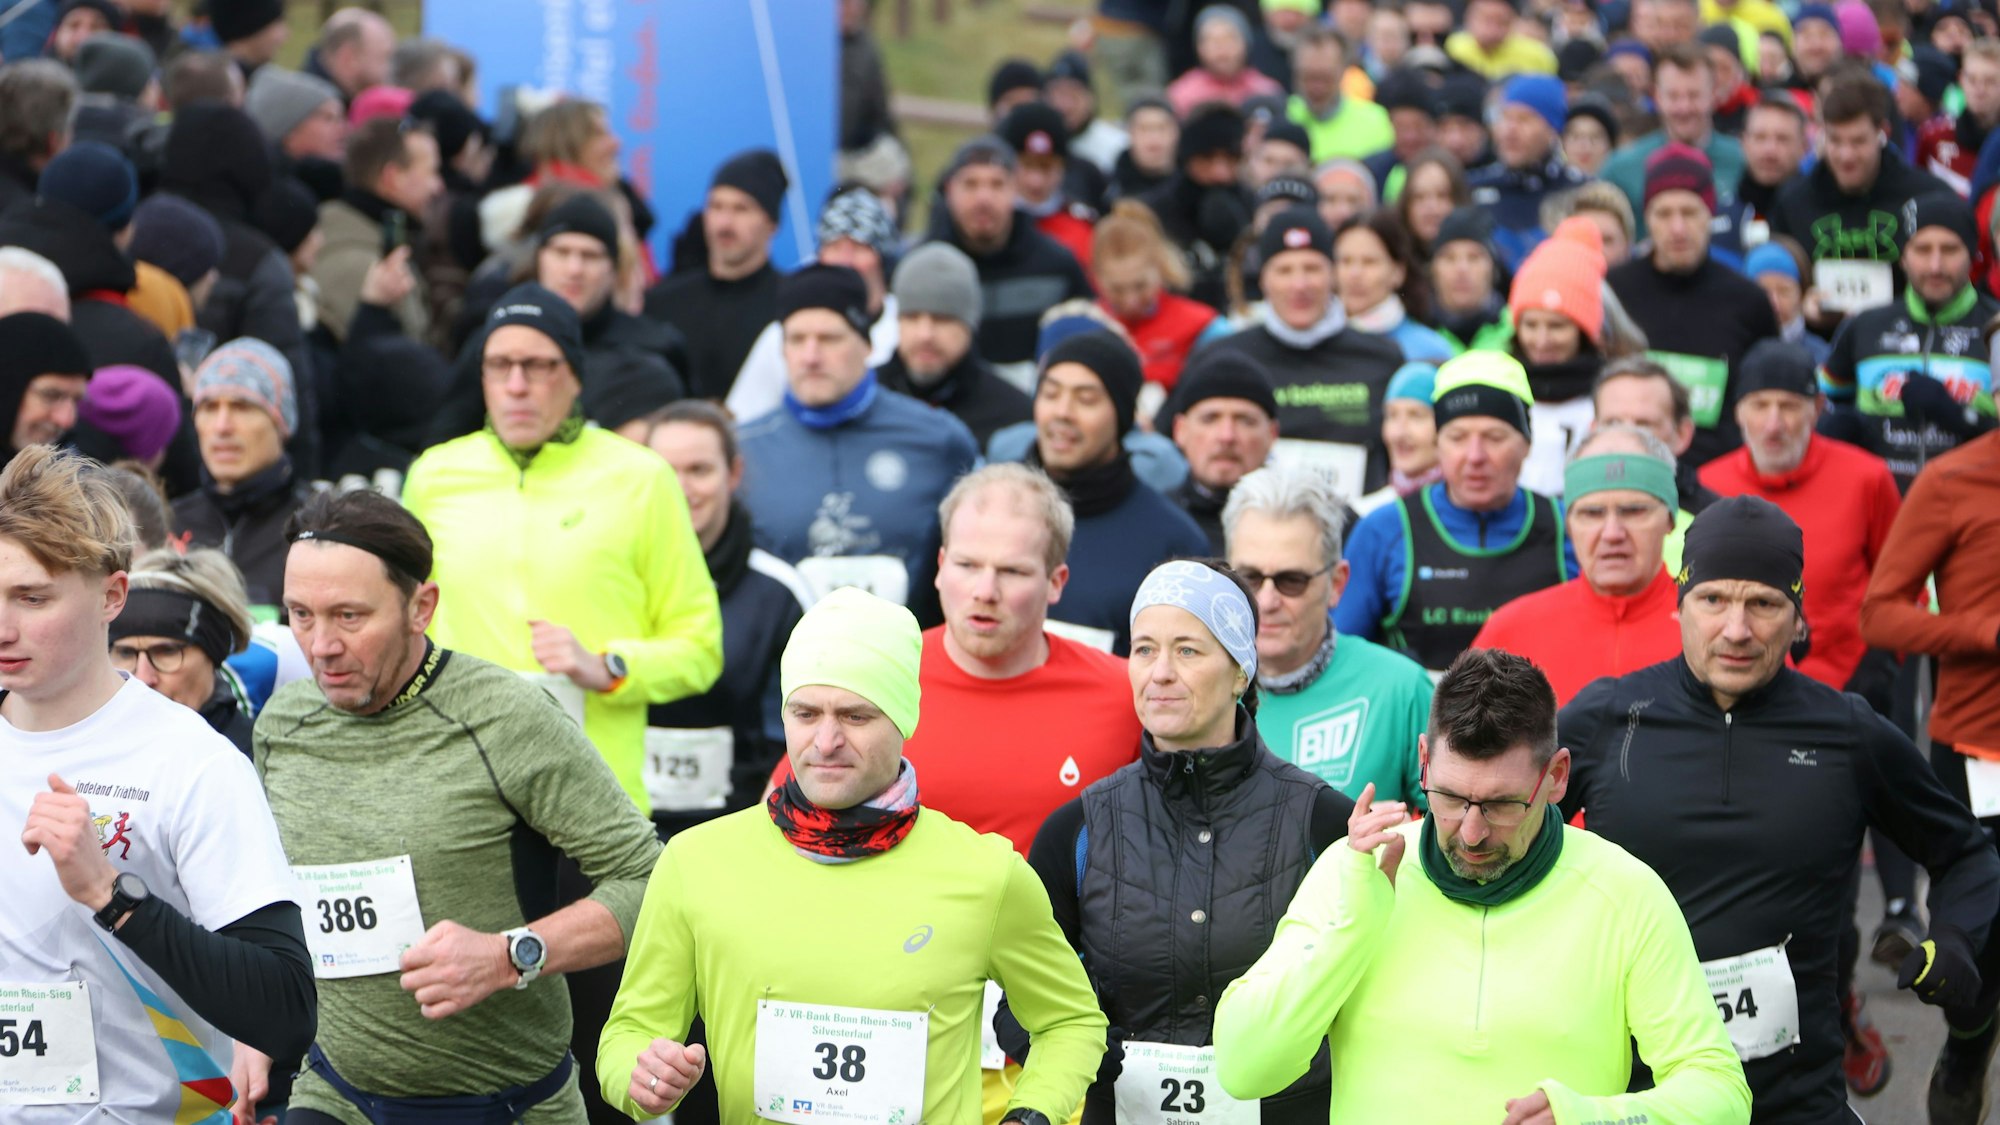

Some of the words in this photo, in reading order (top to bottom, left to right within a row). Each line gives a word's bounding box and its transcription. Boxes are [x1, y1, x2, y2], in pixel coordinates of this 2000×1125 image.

[1422, 606, 1447, 625] LC
[1300, 709, 1360, 766] BTV
[652, 753, 700, 779] 125
[75, 780, 113, 797] indeland
[113, 785, 150, 802] Triathlon
[350, 866, 395, 878] Rhein-Sieg
[317, 896, 378, 934] 386
[1705, 967, 1728, 977] Bonn
[1729, 956, 1774, 972] Rhein-Sieg
[21, 988, 72, 1000] Rhein-Sieg
[1713, 987, 1758, 1024] 54
[774, 1007, 788, 1018] 37.
[790, 1011, 831, 1022] VR-Bank
[833, 1014, 858, 1024] Bonn
[860, 1015, 912, 1029] Rhein-Sieg
[0, 1019, 48, 1057] 54
[812, 1025, 873, 1039] Silvesterlauf
[813, 1042, 866, 1083] 38
[1158, 1063, 1209, 1074] Silvesterlauf
[826, 1087, 848, 1097] Axel
[1160, 1078, 1206, 1114] 23
